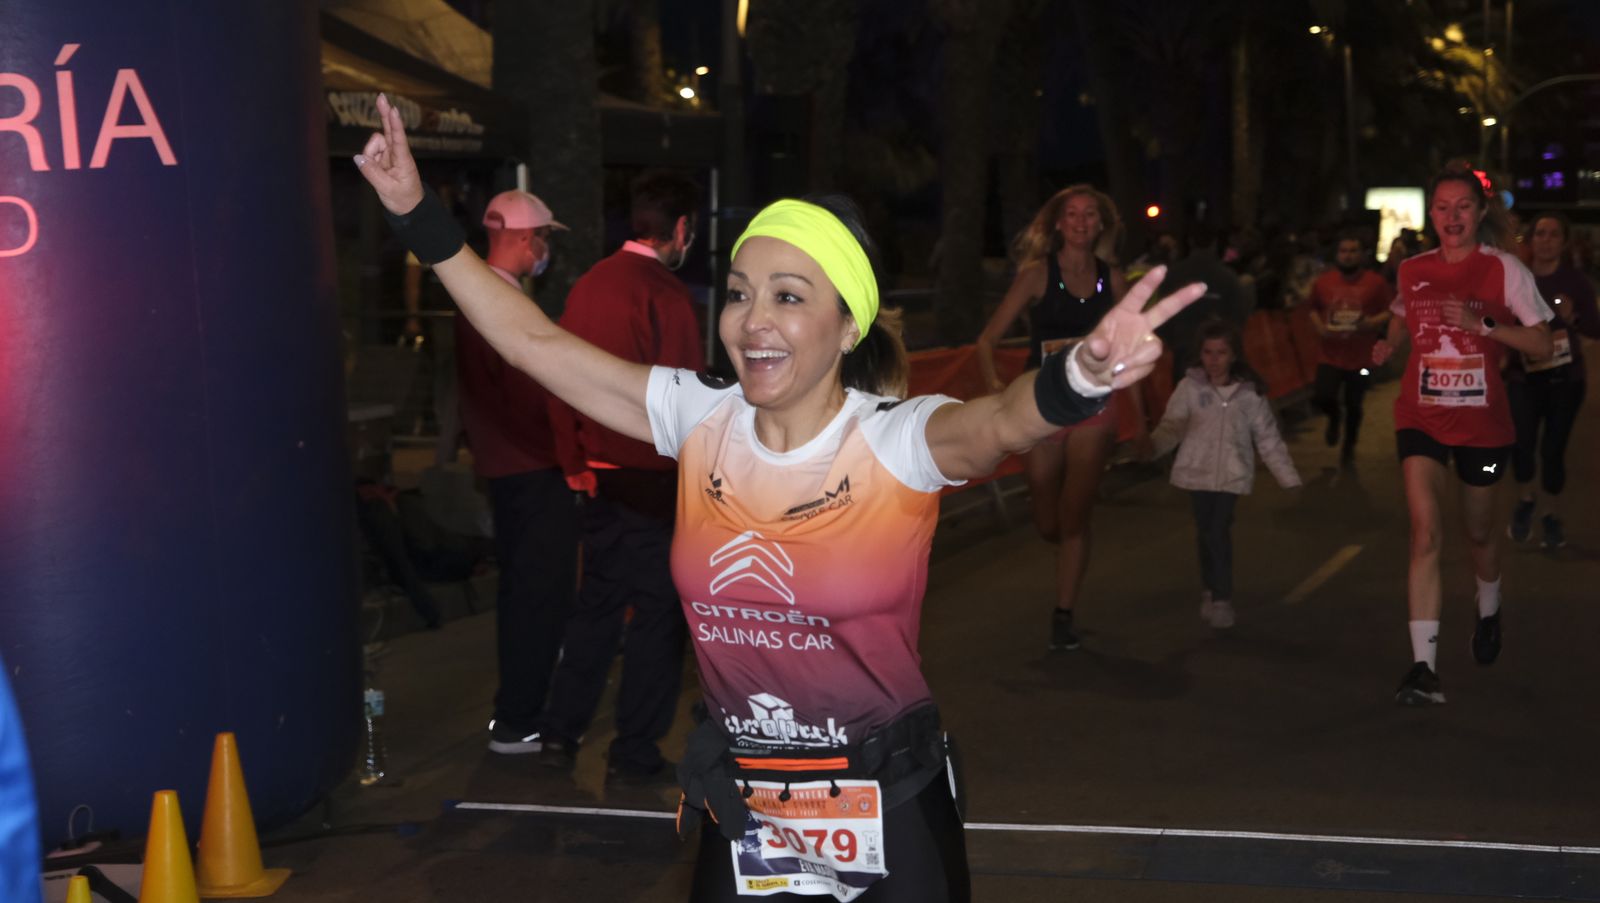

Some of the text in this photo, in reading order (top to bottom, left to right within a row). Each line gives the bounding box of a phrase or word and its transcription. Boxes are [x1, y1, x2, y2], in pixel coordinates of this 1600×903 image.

[0, 43, 178, 171] RÍA
[1430, 373, 1475, 387] 3070
[697, 623, 835, 651] SALINAS CAR
[761, 820, 858, 863] 3079
